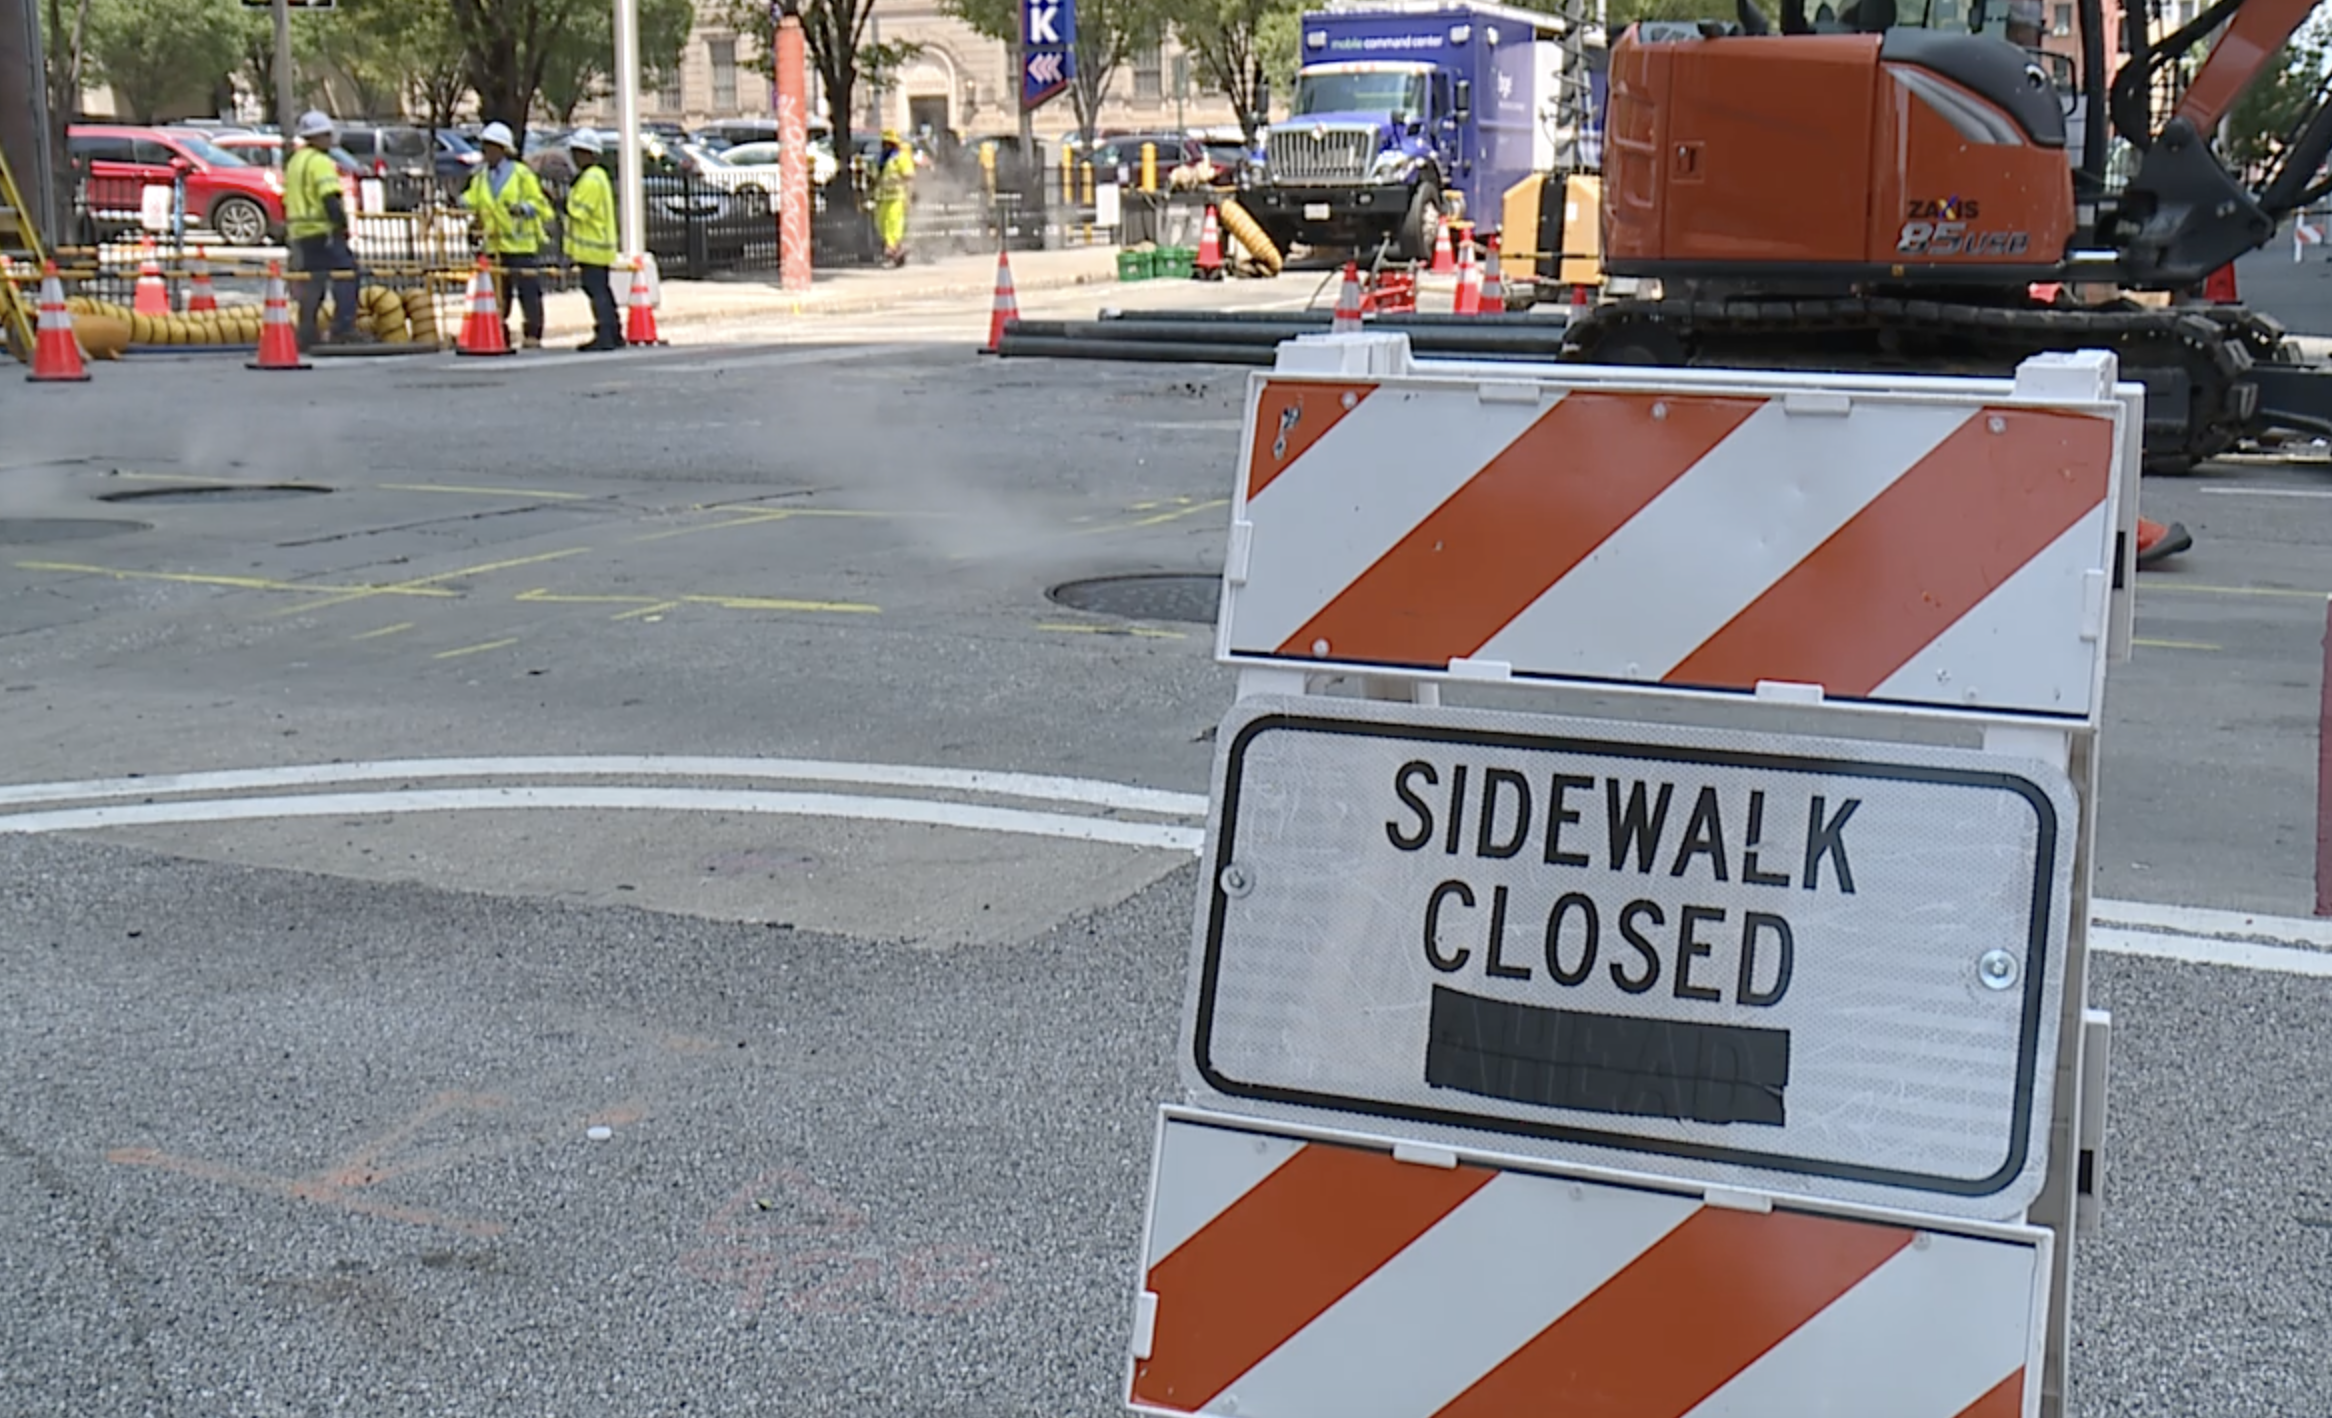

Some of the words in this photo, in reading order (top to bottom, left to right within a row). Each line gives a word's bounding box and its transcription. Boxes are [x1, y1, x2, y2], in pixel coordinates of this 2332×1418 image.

[1029, 0, 1060, 43] K
[1331, 36, 1362, 49] mobile
[1363, 35, 1410, 49] command
[1411, 35, 1443, 48] center
[1908, 195, 1979, 220] ZAXIS
[1386, 759, 1862, 895] SIDEWALK
[1424, 879, 1795, 1007] CLOSED
